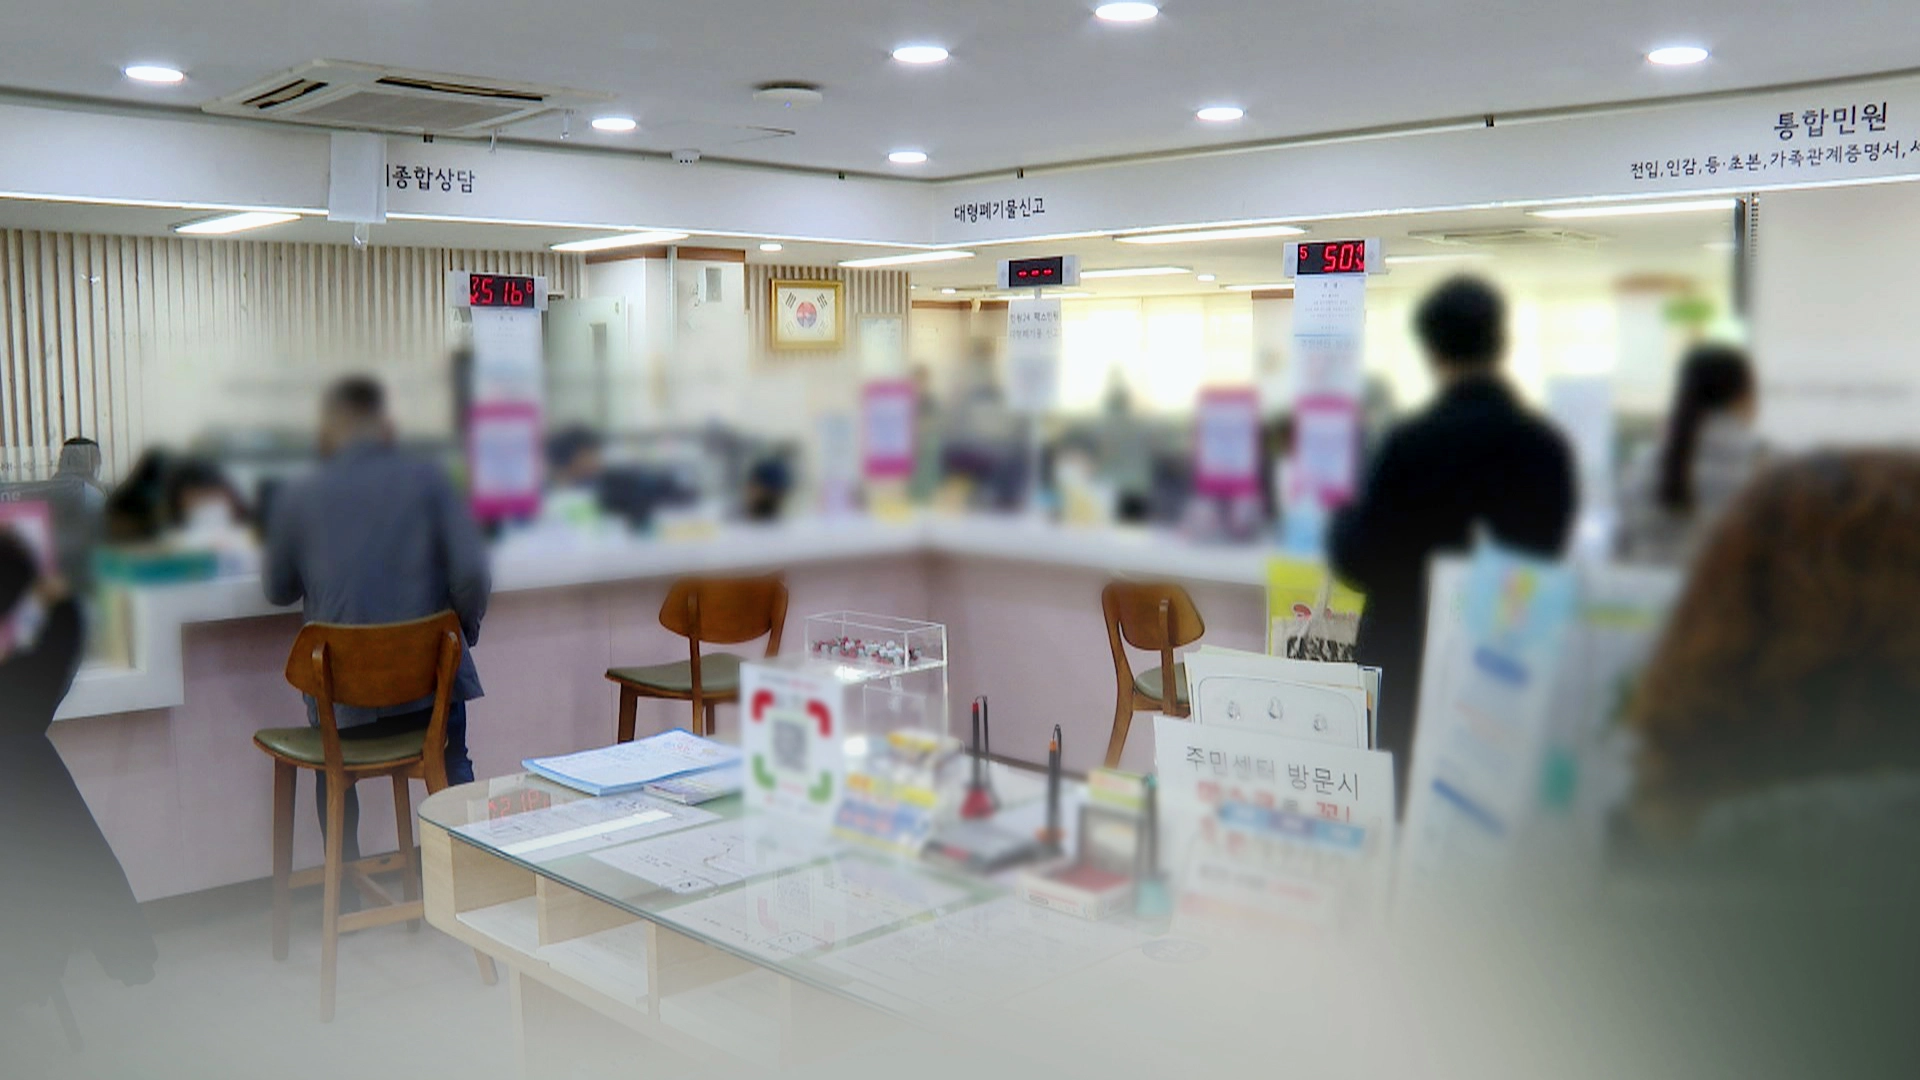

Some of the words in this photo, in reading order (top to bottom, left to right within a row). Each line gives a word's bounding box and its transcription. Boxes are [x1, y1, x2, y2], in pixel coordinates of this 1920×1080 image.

[1773, 101, 1888, 141] 통합민원
[953, 196, 1045, 223] 대형폐기물신고
[1185, 745, 1276, 785] 주민센터
[1287, 762, 1360, 802] 방문시
